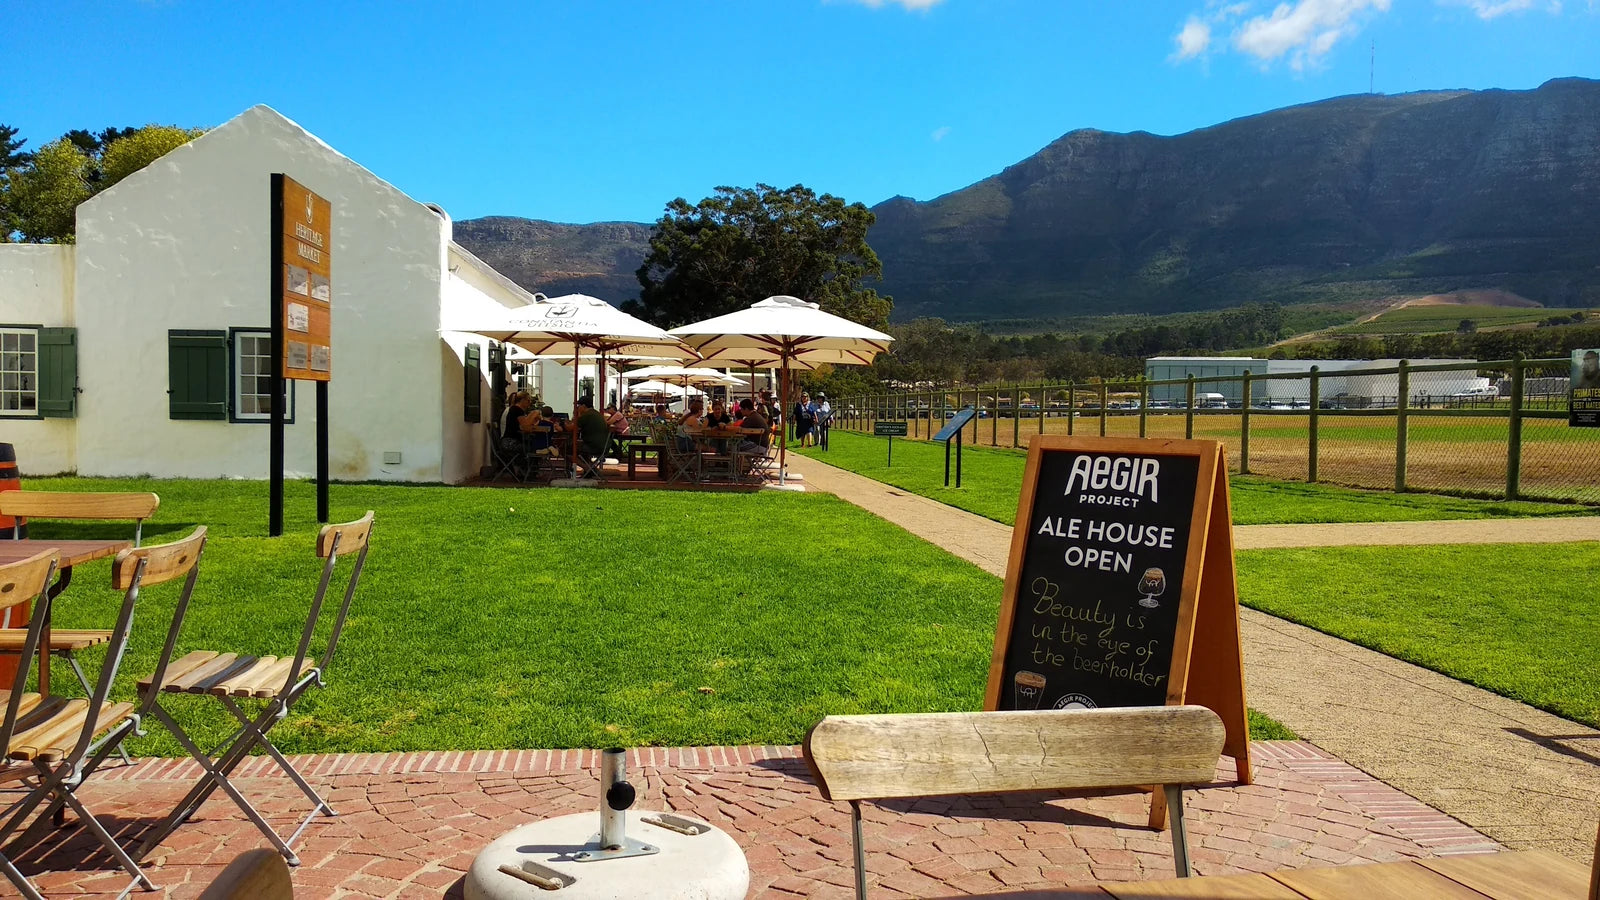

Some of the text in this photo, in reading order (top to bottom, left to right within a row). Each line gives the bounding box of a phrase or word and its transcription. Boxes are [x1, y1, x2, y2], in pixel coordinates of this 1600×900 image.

[295, 221, 323, 247] HERITAGE
[298, 241, 320, 264] MARKET
[1079, 494, 1139, 508] PROJECT
[1038, 516, 1175, 549] ALE HOUSE
[1064, 546, 1133, 574] OPEN
[1031, 576, 1147, 638] Beauty is
[1031, 622, 1159, 667] in the eye of
[1031, 643, 1166, 687] the beerholder
[1057, 695, 1095, 709] AEGIR PROJEC
